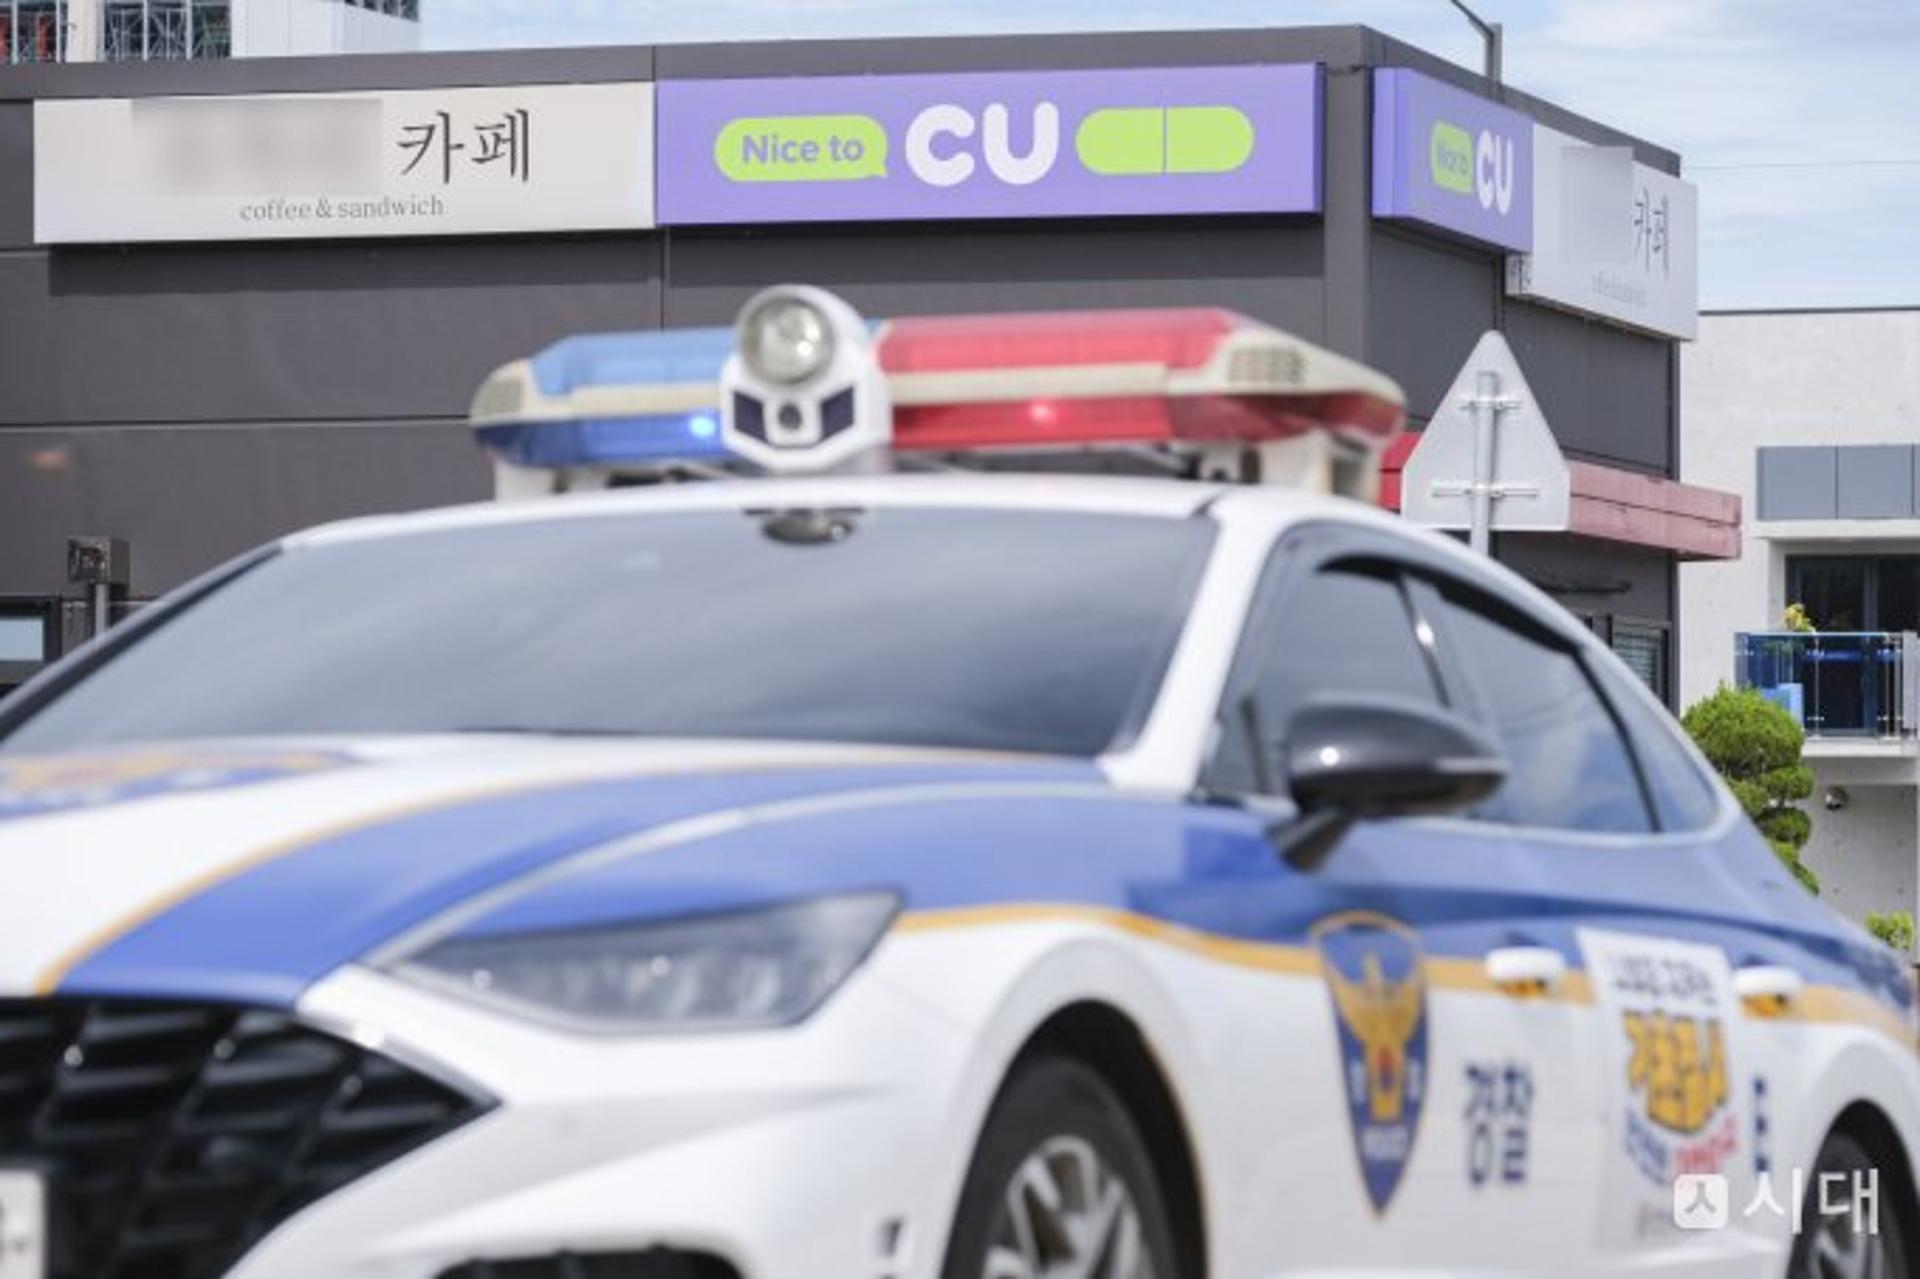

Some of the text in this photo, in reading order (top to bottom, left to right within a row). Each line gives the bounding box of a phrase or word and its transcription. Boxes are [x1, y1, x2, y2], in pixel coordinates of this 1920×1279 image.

[397, 108, 530, 184] 카페
[741, 101, 1060, 187] Nice to CU
[1477, 129, 1514, 216] CU
[239, 199, 312, 221] coffee
[337, 194, 445, 219] sandwich
